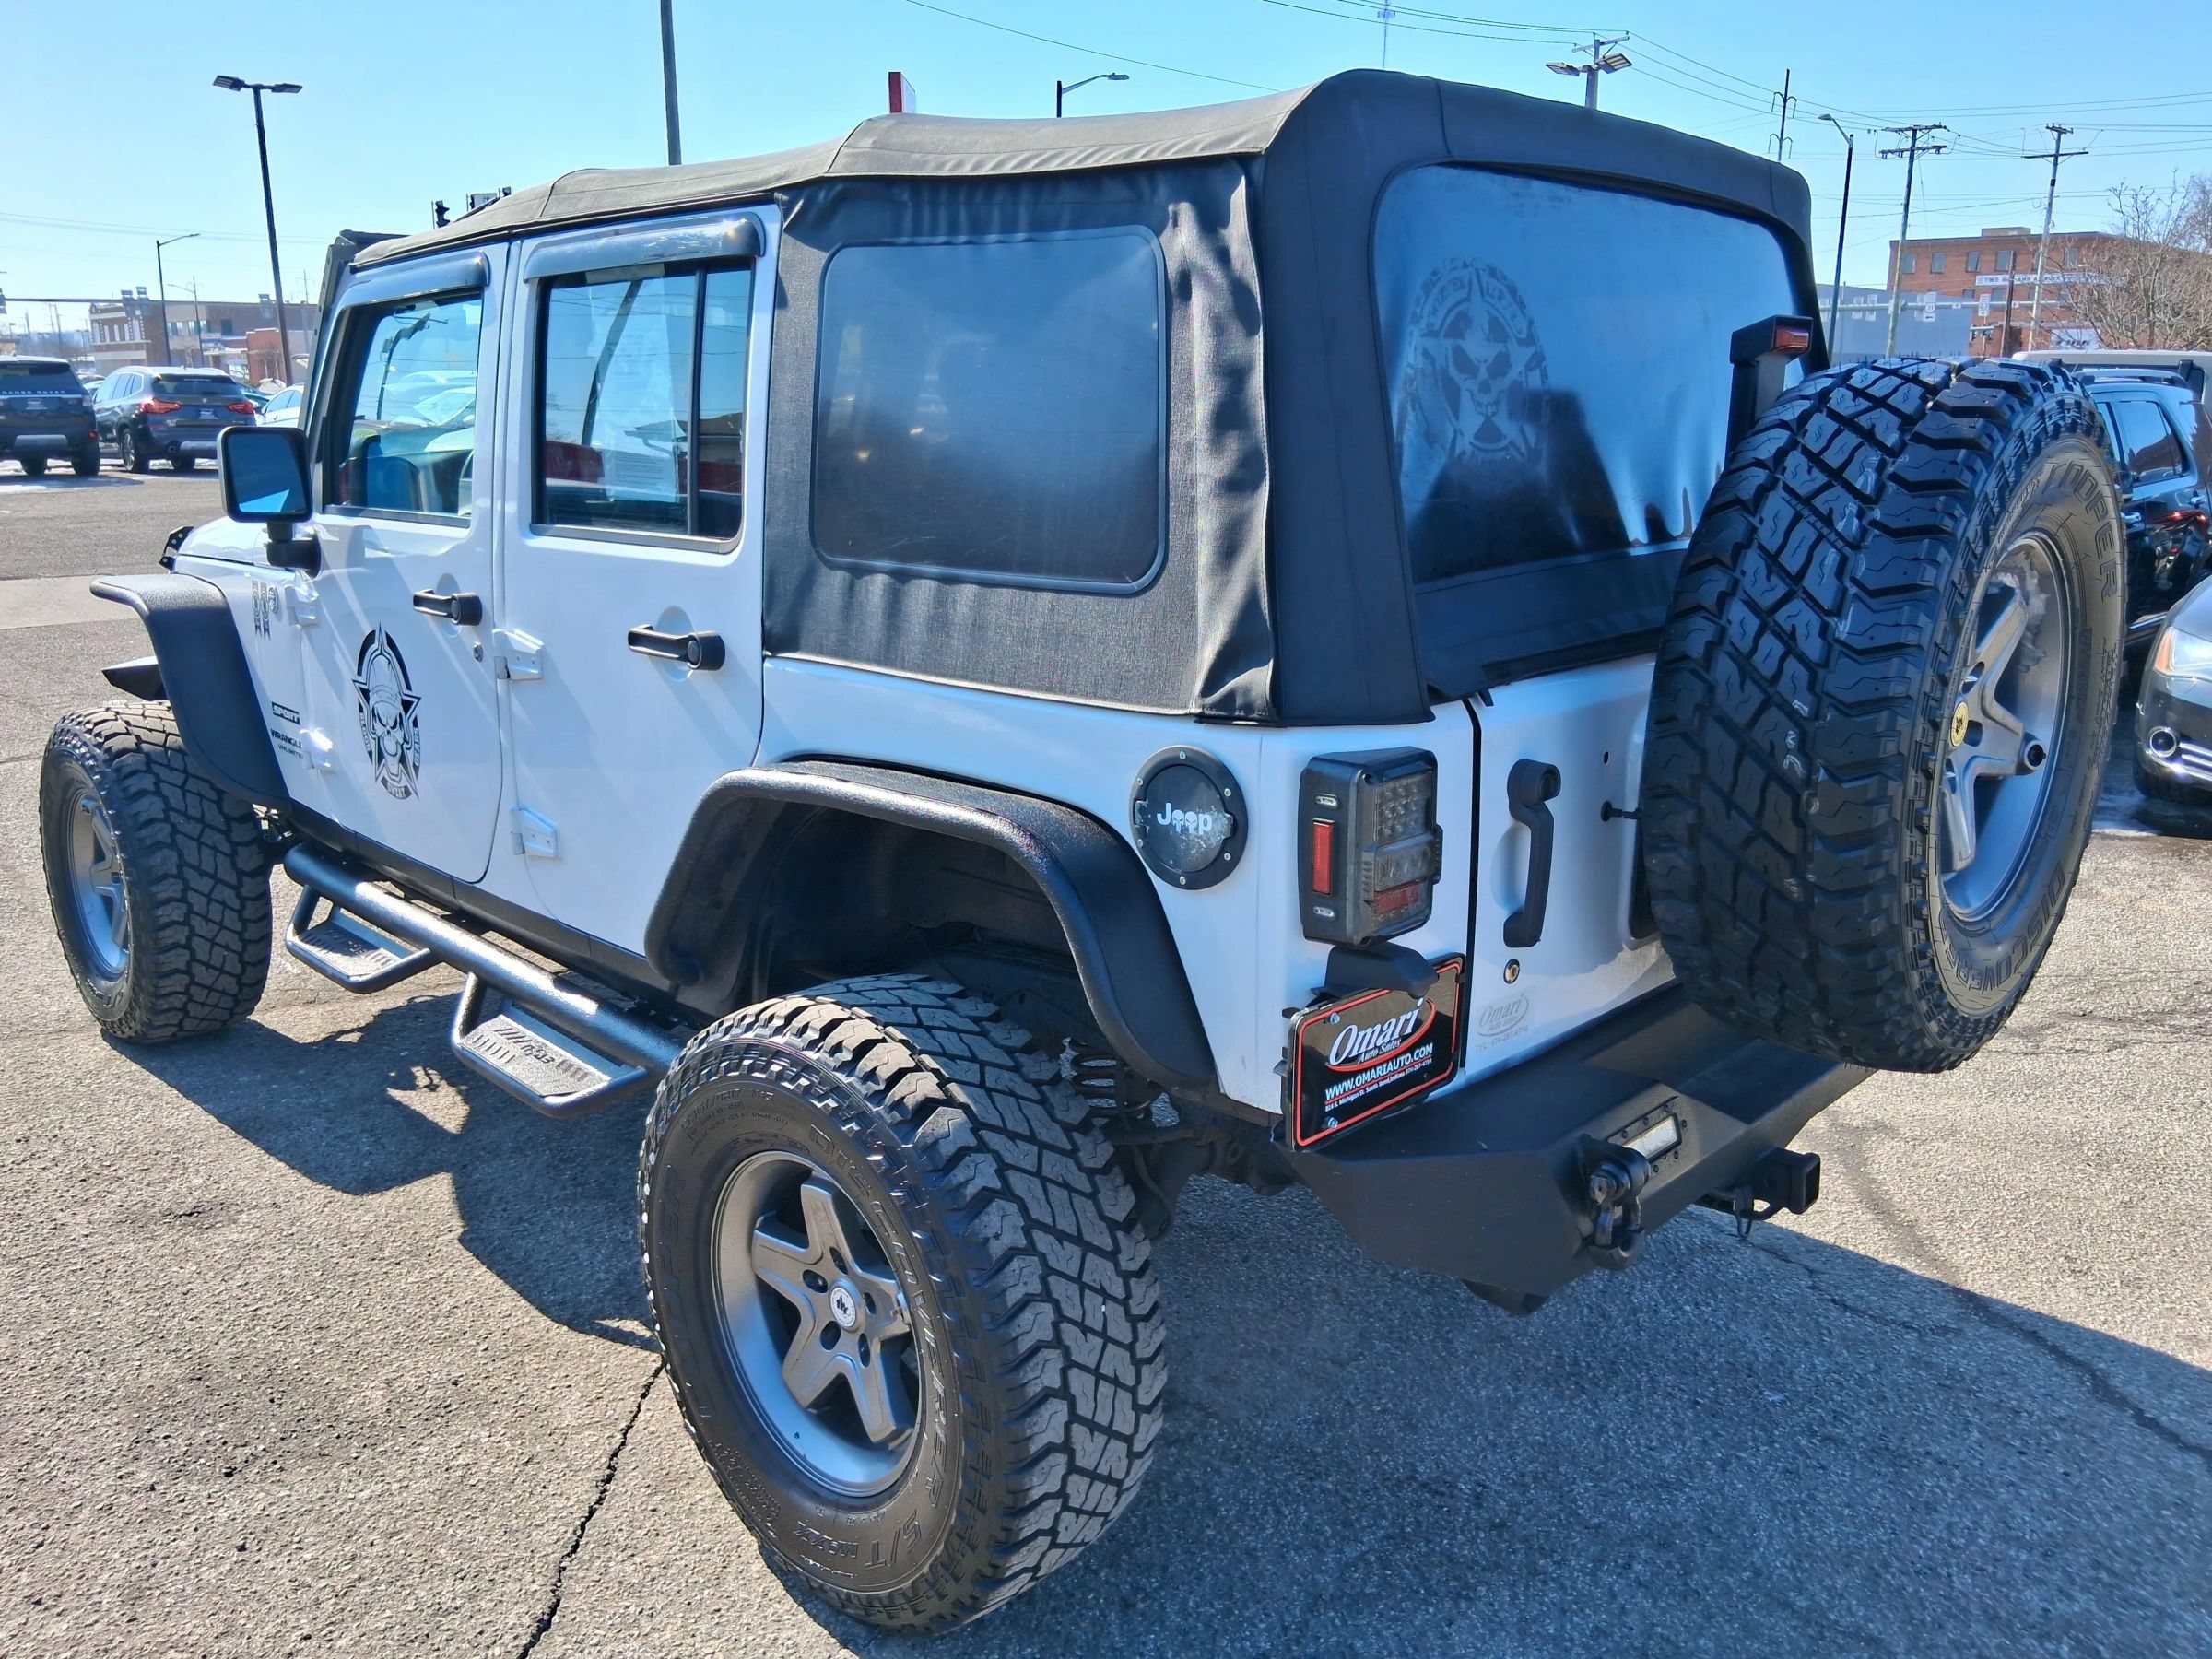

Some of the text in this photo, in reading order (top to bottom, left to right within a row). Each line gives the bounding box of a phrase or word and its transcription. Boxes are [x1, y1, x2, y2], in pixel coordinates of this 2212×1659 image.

[2041, 460, 2118, 604] COOPER
[273, 704, 300, 724] SPORT
[359, 712, 371, 752] BLOOD
[1329, 997, 1424, 1065] Omari
[1479, 993, 1525, 1028] Omari
[1325, 1042, 1433, 1100] WWW.OMARIAUTO.COM
[1358, 1039, 1402, 1064] Auto Sales
[1338, 1092, 1359, 1105] Michigan
[808, 1123, 947, 1508] DISCOVERER
[865, 1508, 923, 1569] S/T
